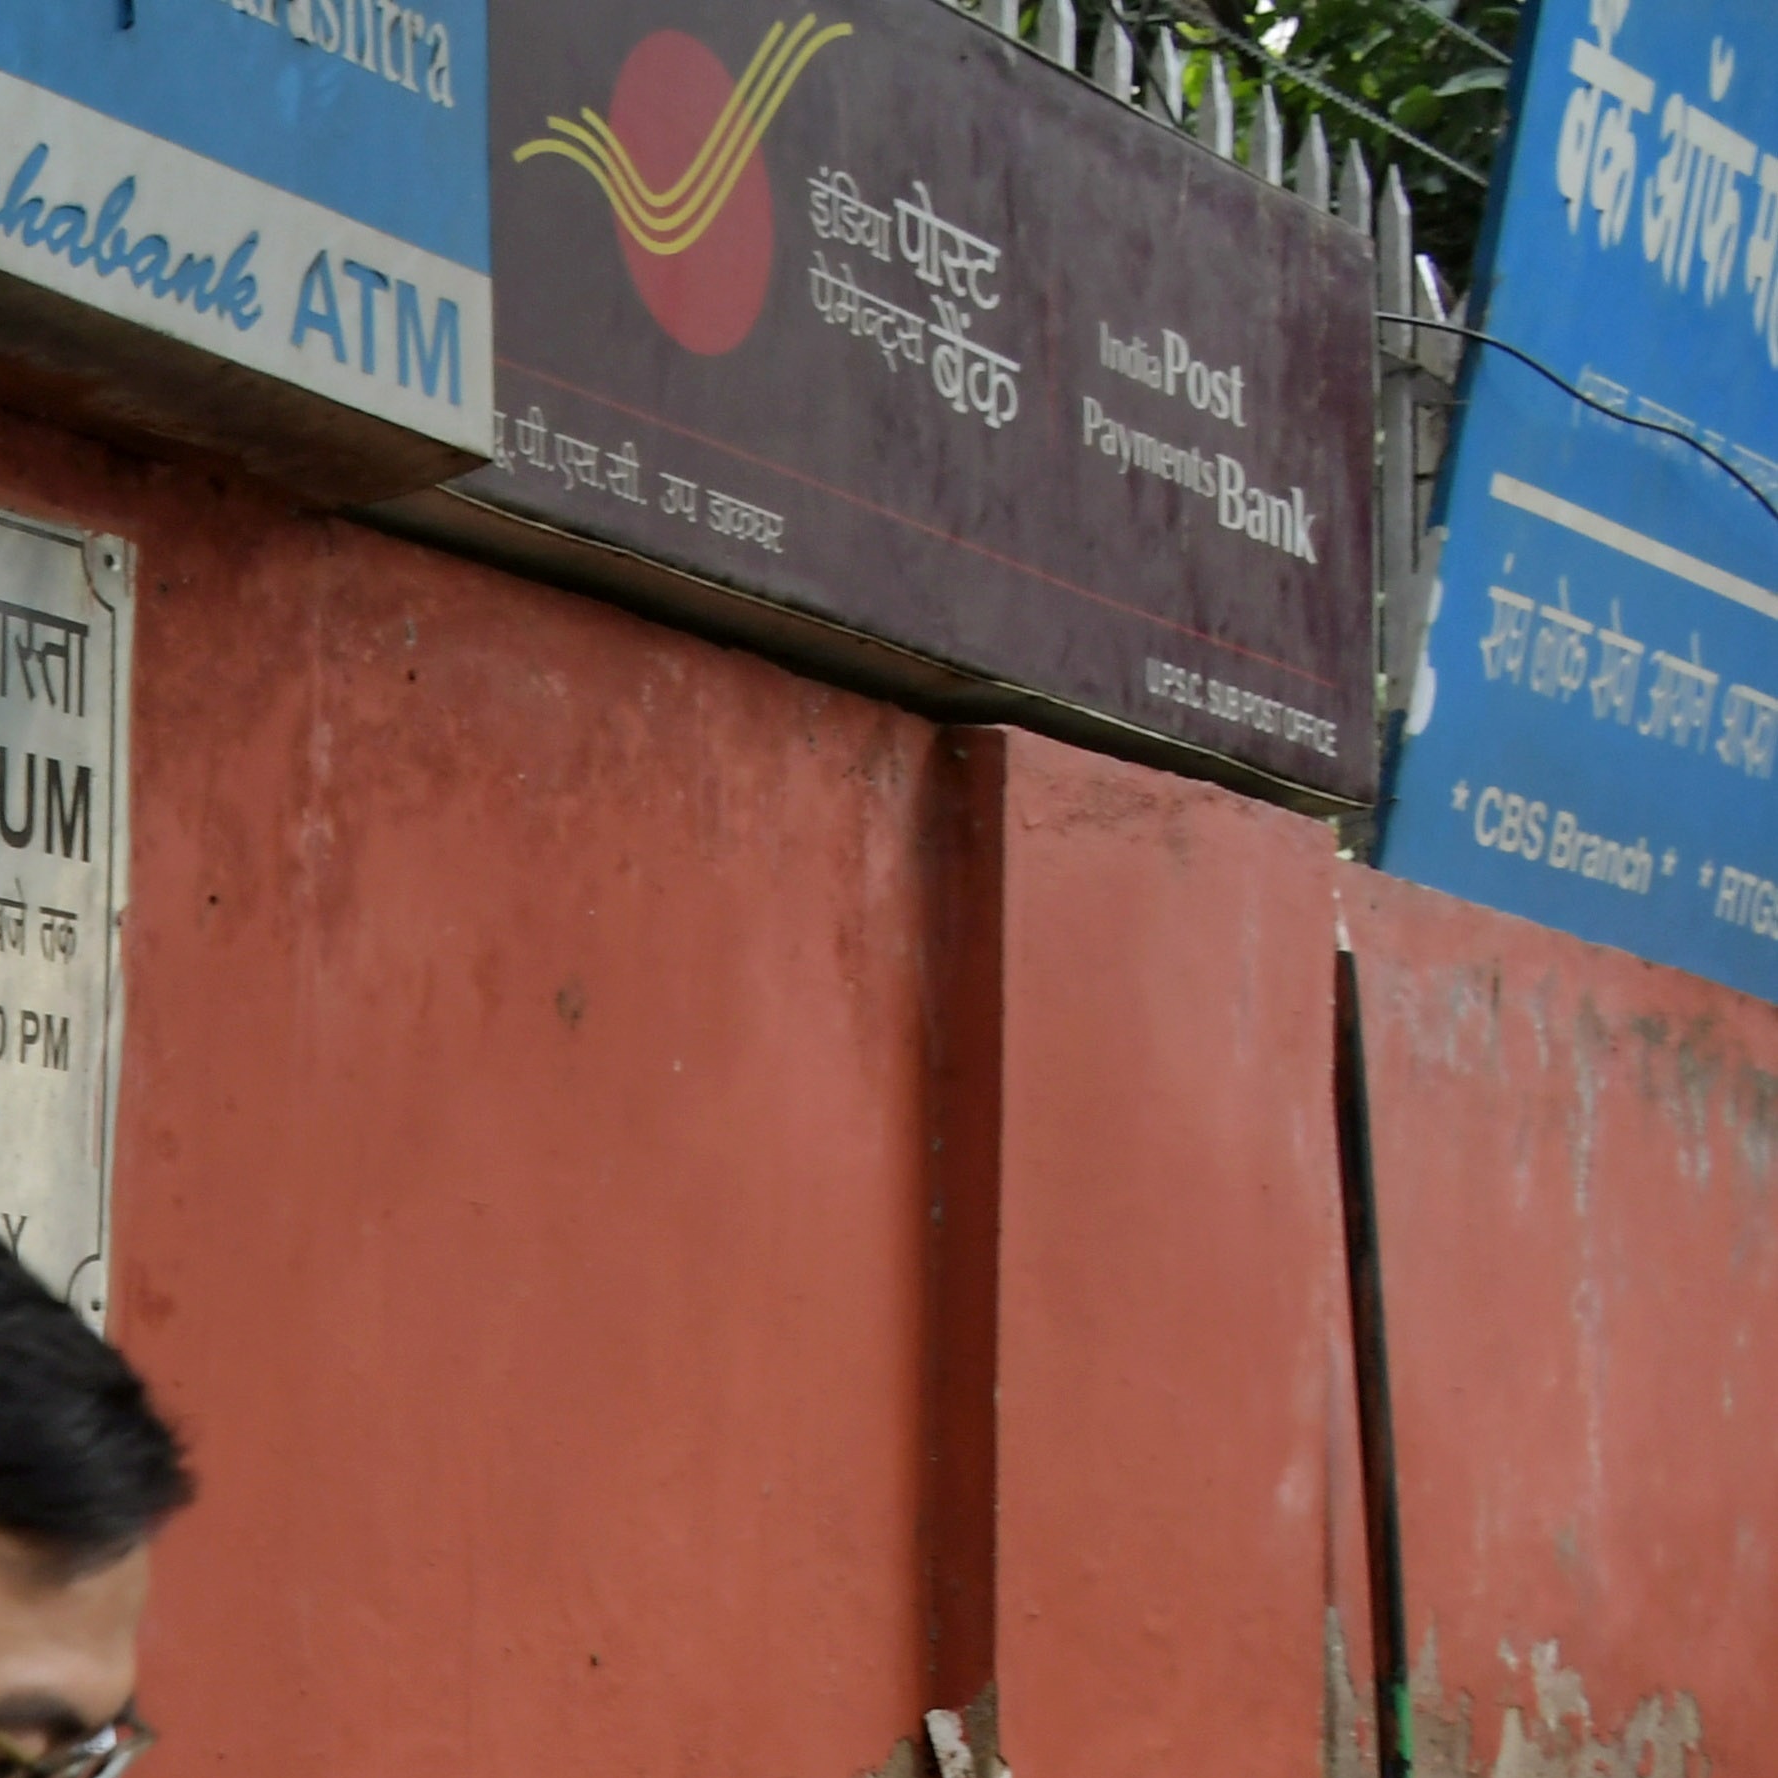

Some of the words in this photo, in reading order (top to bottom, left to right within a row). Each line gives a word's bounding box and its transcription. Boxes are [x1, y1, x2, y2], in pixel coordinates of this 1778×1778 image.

[291, 249, 462, 407] ATM
[1475, 785, 1549, 861] CBS
[1548, 810, 1654, 895] Branch
[39, 905, 79, 965] तक
[20, 1010, 70, 1072] PM
